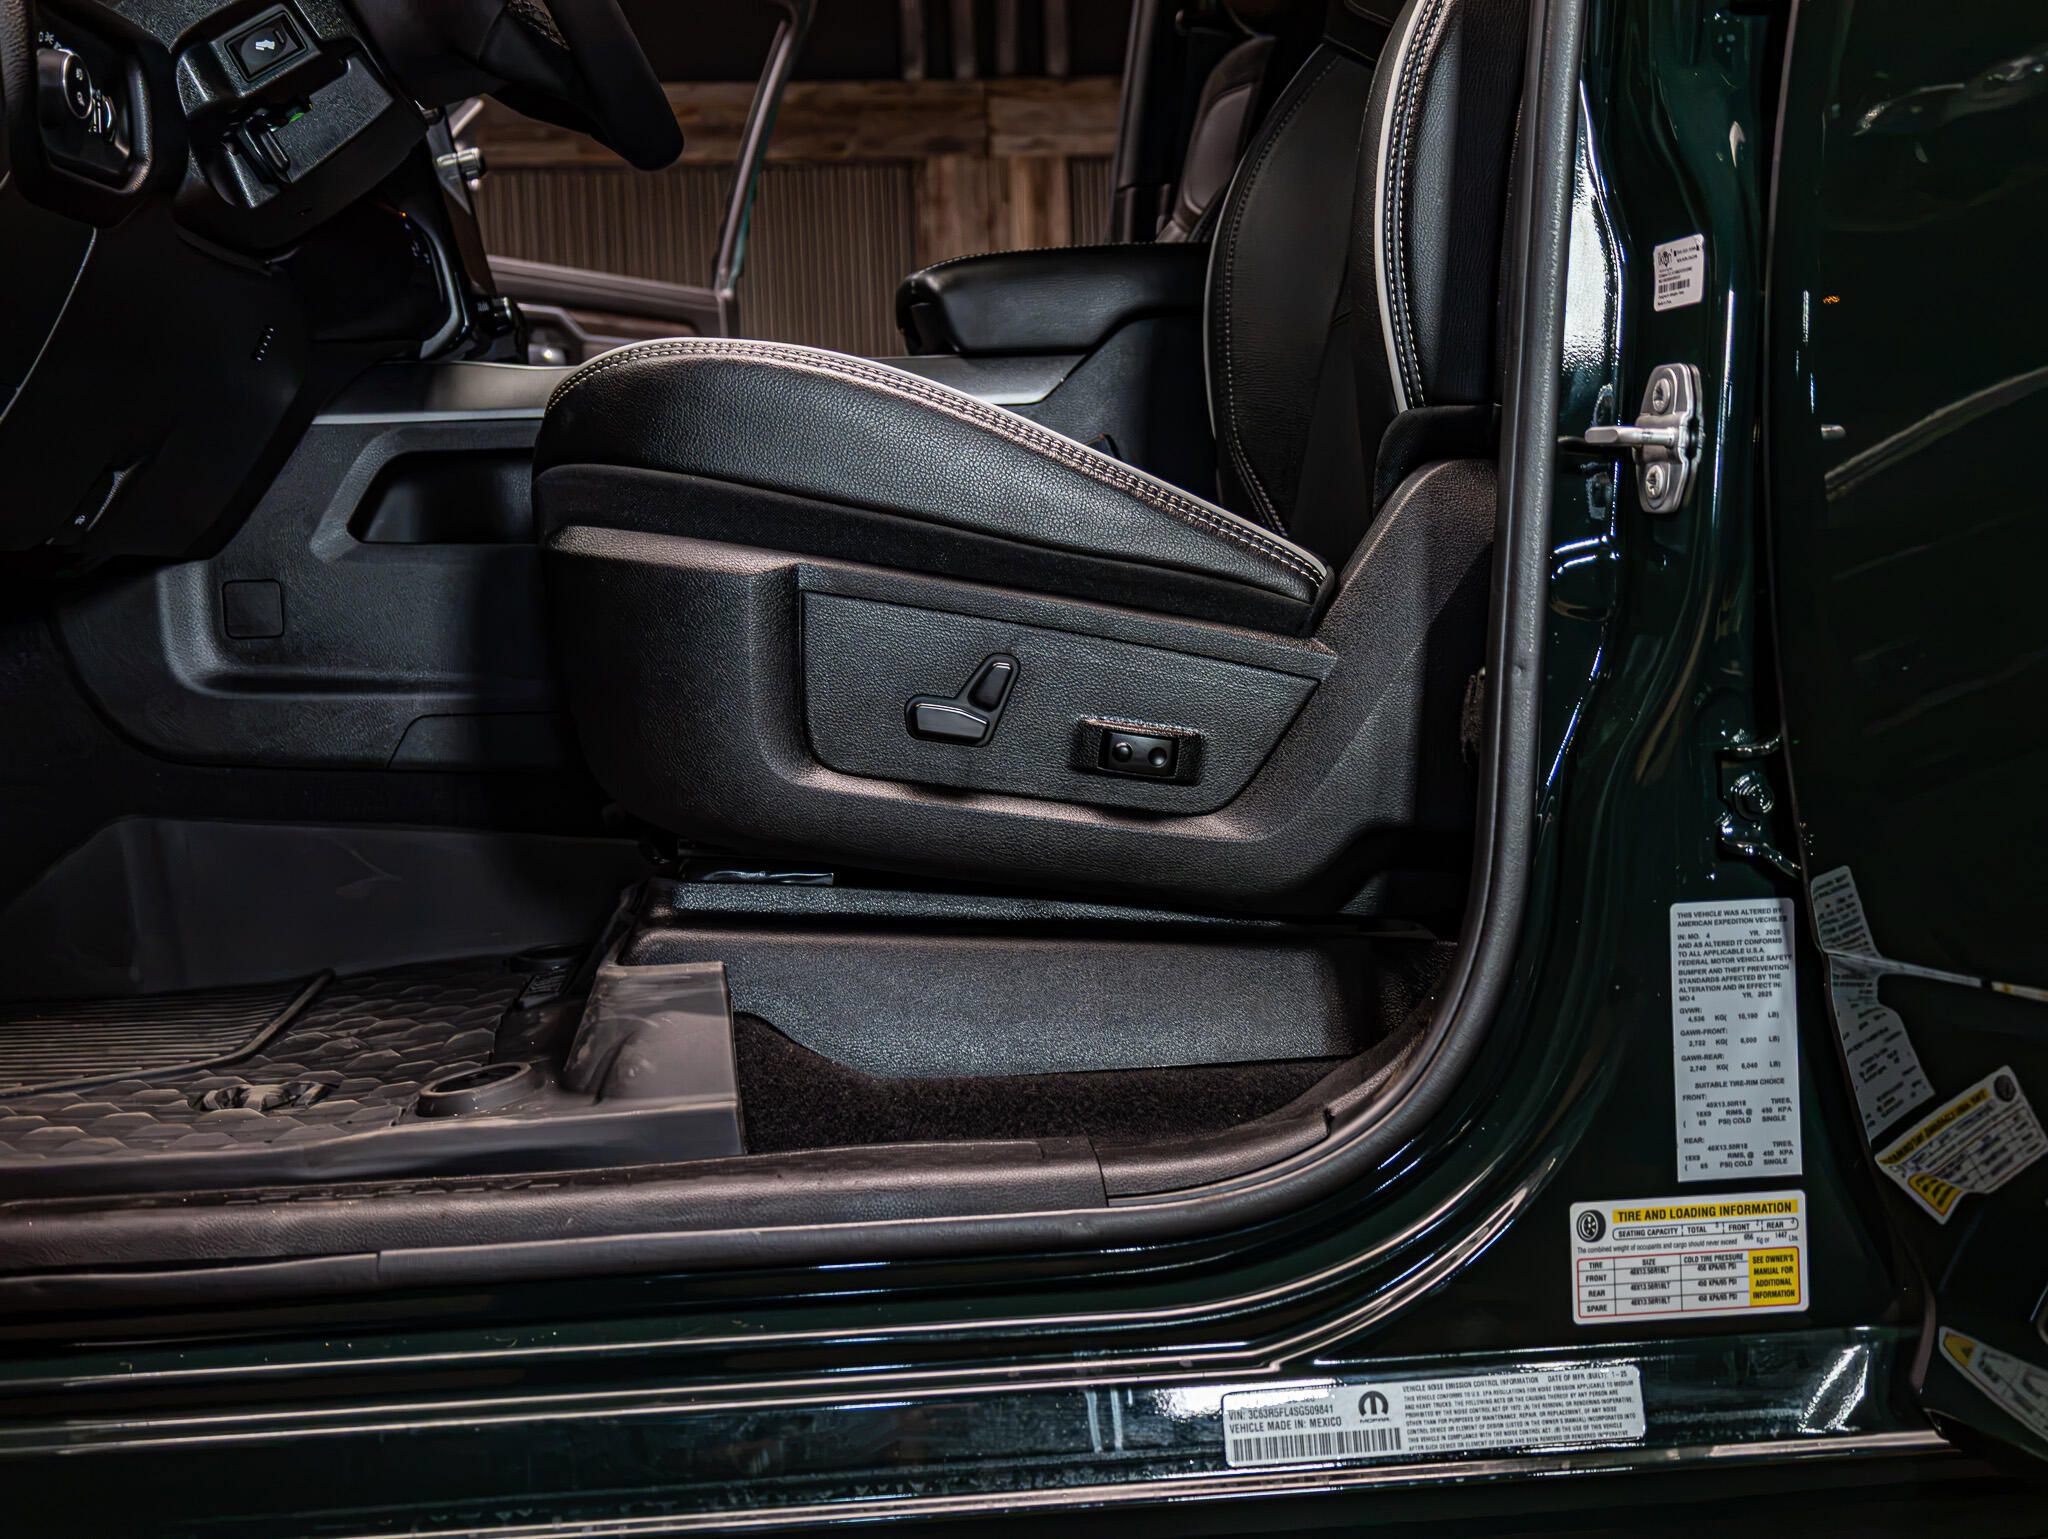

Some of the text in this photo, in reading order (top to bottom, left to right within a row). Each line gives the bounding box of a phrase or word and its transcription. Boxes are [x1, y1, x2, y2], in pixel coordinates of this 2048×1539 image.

[1618, 1202, 1791, 1222] TIRE AND LOADING INFORMATION
[1618, 1229, 1645, 1238] SEATING
[1647, 1228, 1678, 1236] CAPACITY
[1766, 1254, 1794, 1262] OWNER'S
[1754, 1267, 1779, 1275] MANUAL
[1756, 1278, 1792, 1287] ADDITIONAL
[1753, 1289, 1795, 1299] INFORMATION
[1402, 1384, 1425, 1392] VEHICLE
[1500, 1377, 1538, 1385] INFORMATION
[1228, 1410, 1245, 1420] VIN:
[1229, 1416, 1342, 1434] VEHICLE MADE IN: MEXICO
